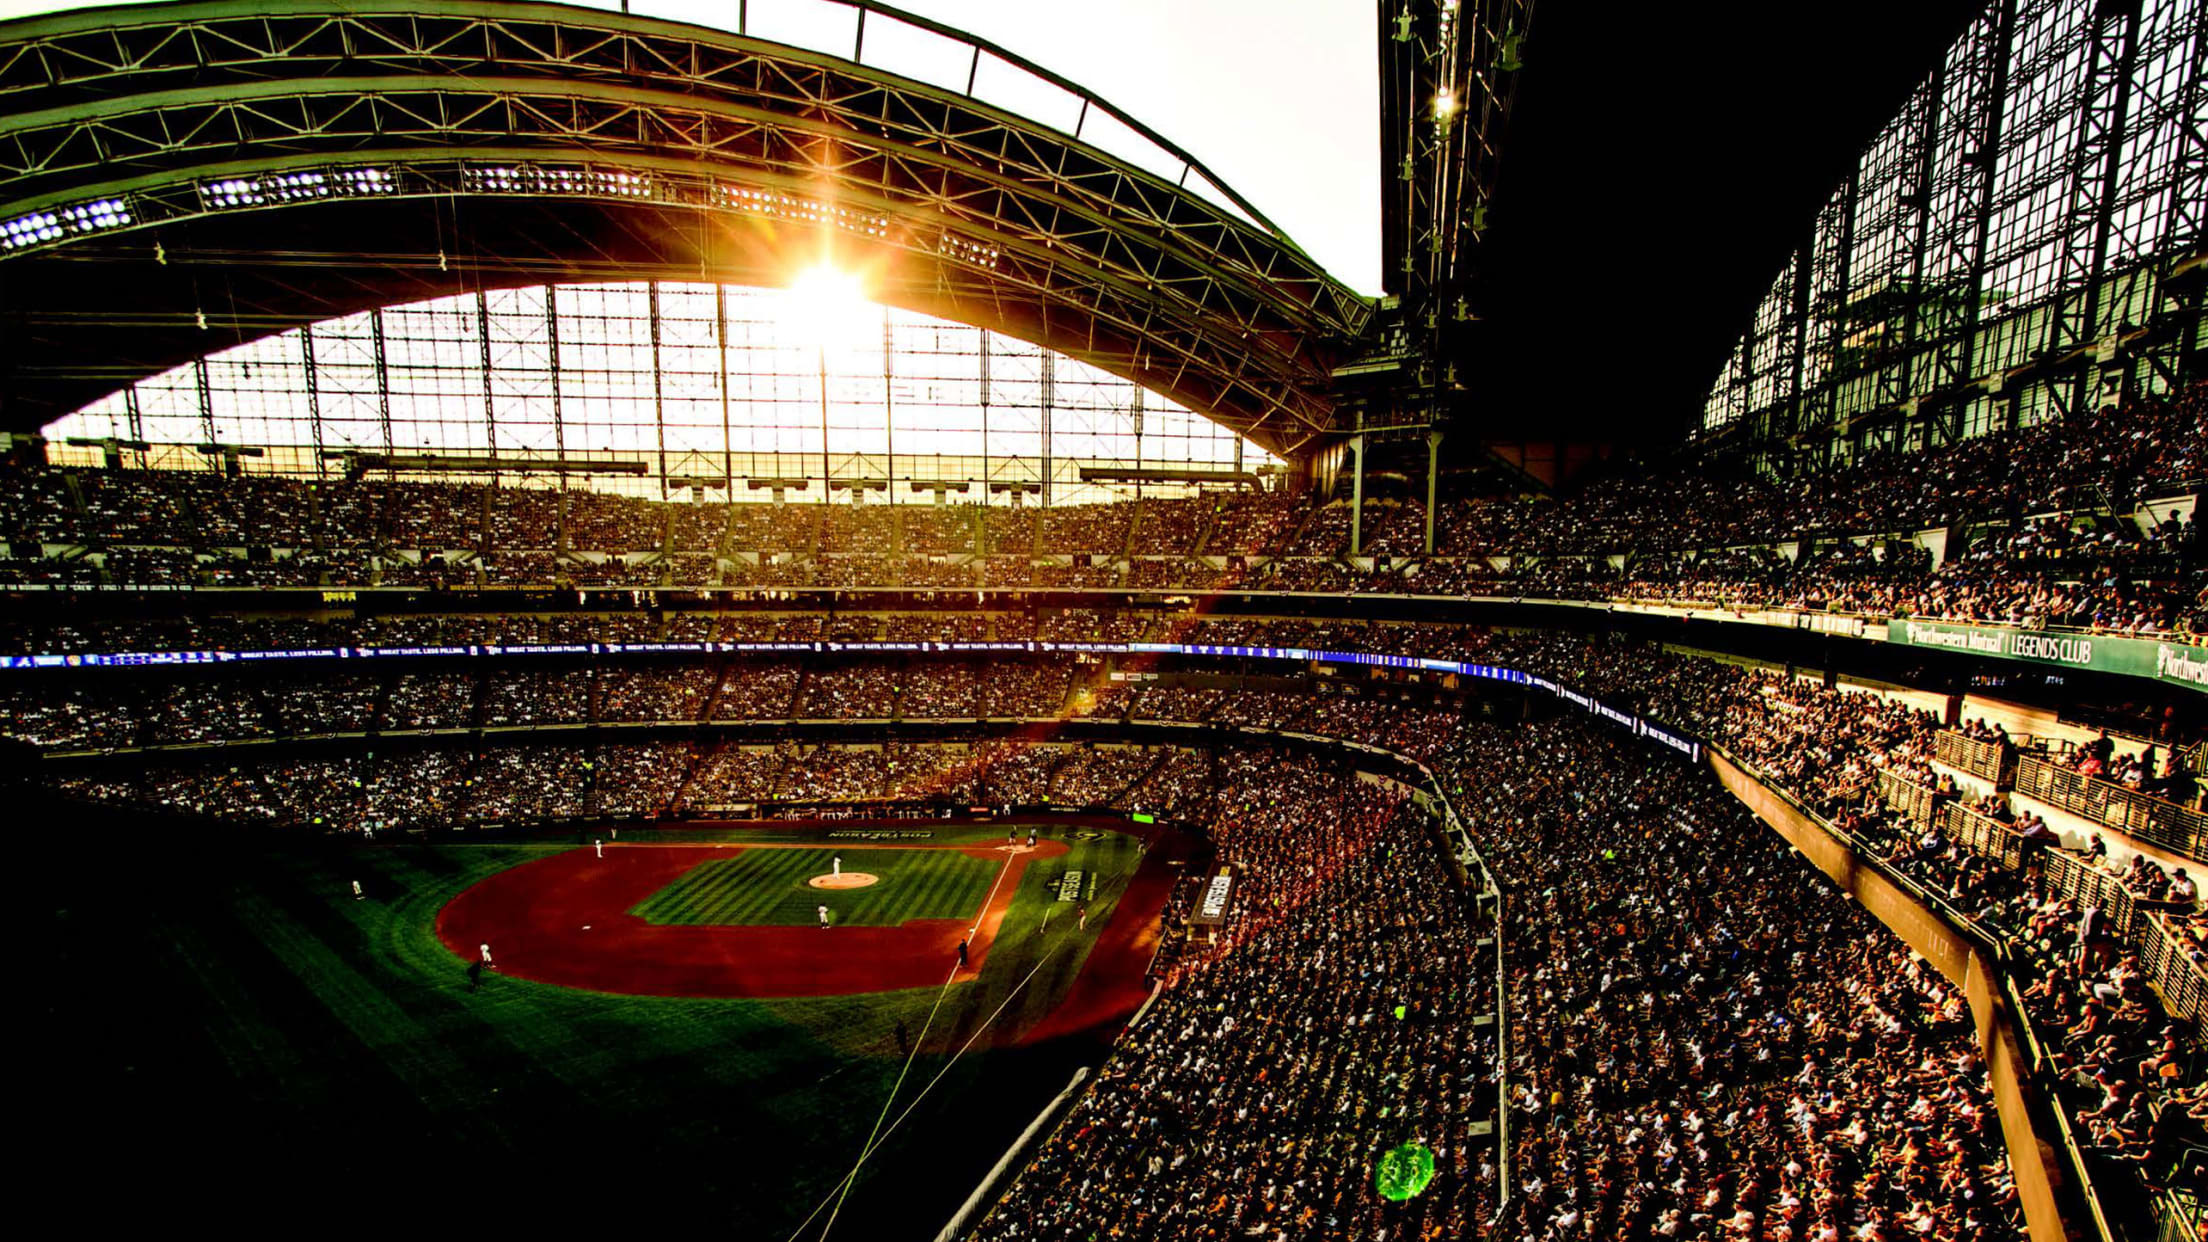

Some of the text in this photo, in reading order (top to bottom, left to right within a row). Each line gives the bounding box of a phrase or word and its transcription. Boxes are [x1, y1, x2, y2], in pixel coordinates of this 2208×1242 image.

[1073, 608, 1093, 617] PNC
[1914, 625, 2092, 664] Northwestern Mutual LEGENDS CLUB
[828, 831, 933, 839] POSTSEASON
[1057, 871, 1083, 902] POSTSEASON
[1203, 876, 1232, 909] POSTSEASON
